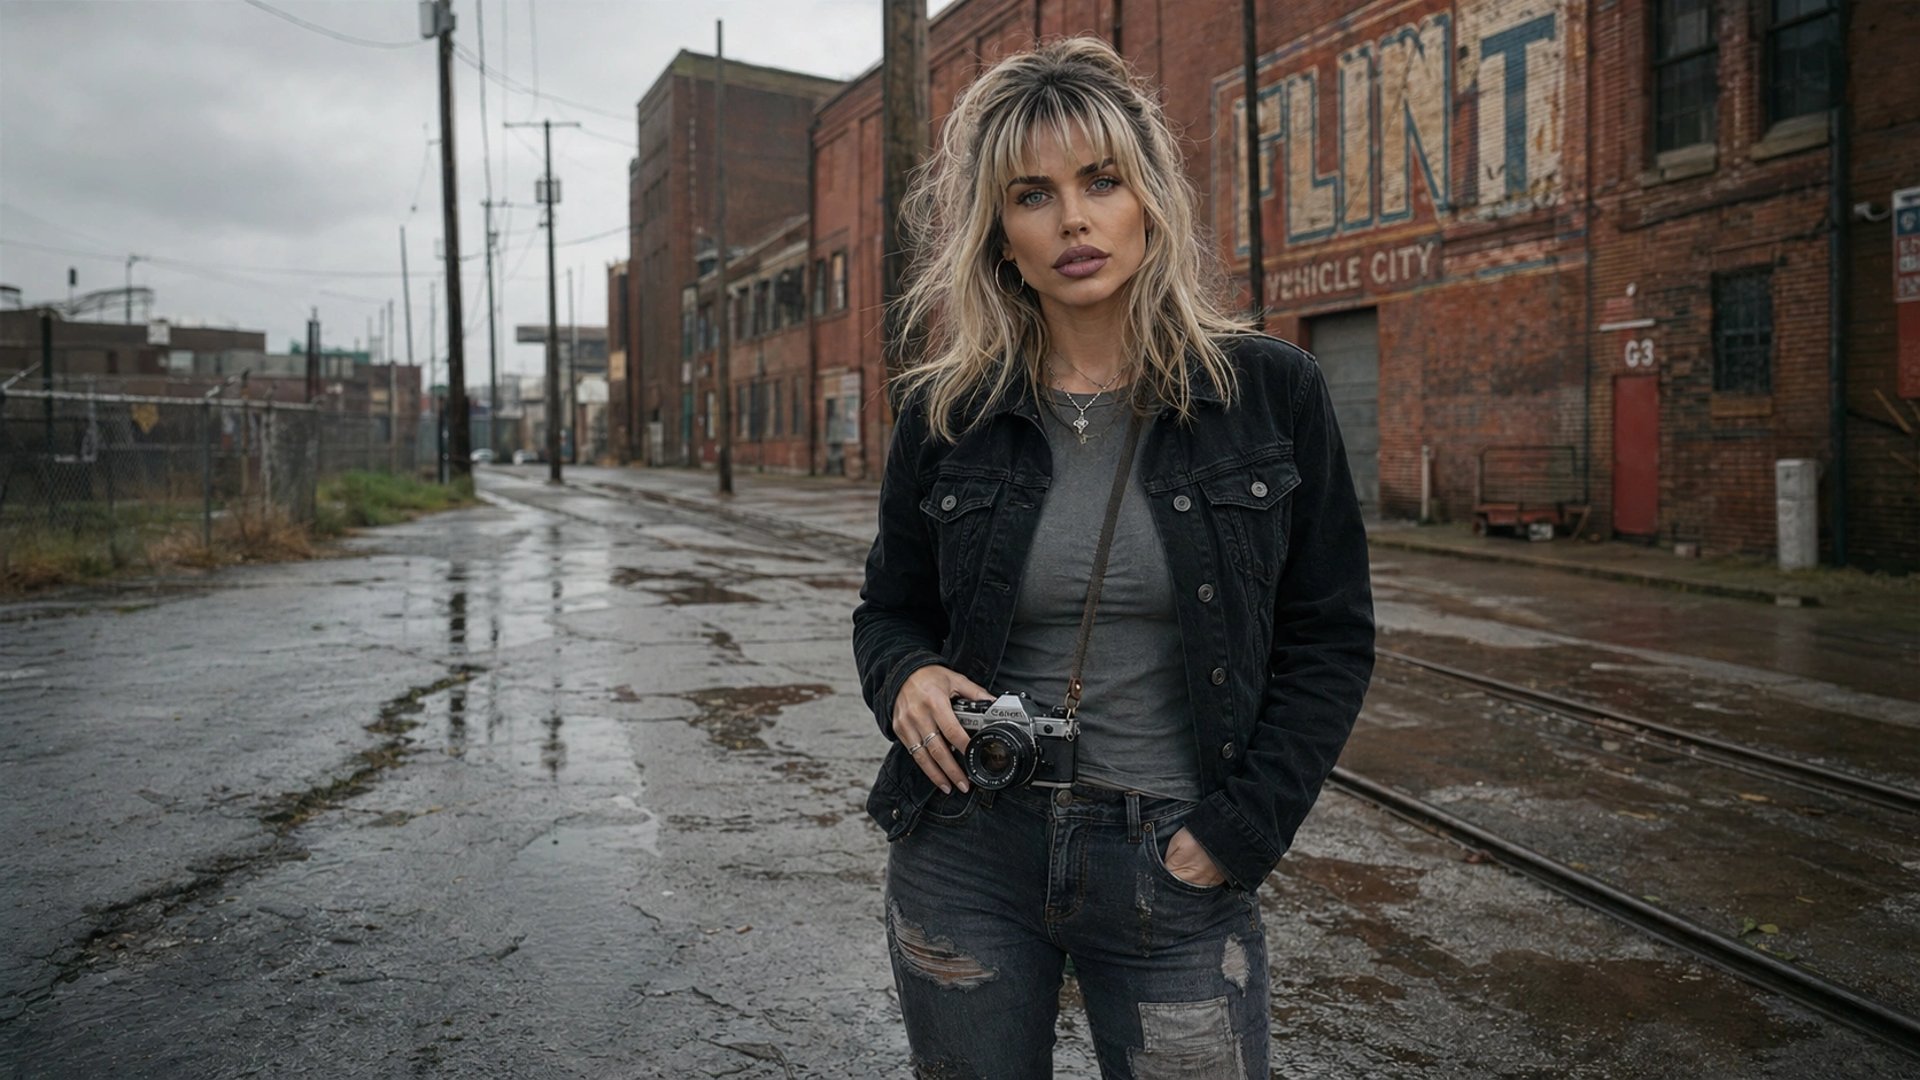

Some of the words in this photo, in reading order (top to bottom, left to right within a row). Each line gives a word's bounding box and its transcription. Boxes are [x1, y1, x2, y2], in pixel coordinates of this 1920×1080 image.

[1235, 13, 1557, 257] FLINT
[1371, 242, 1434, 285] CITY
[1625, 339, 1654, 367] G3
